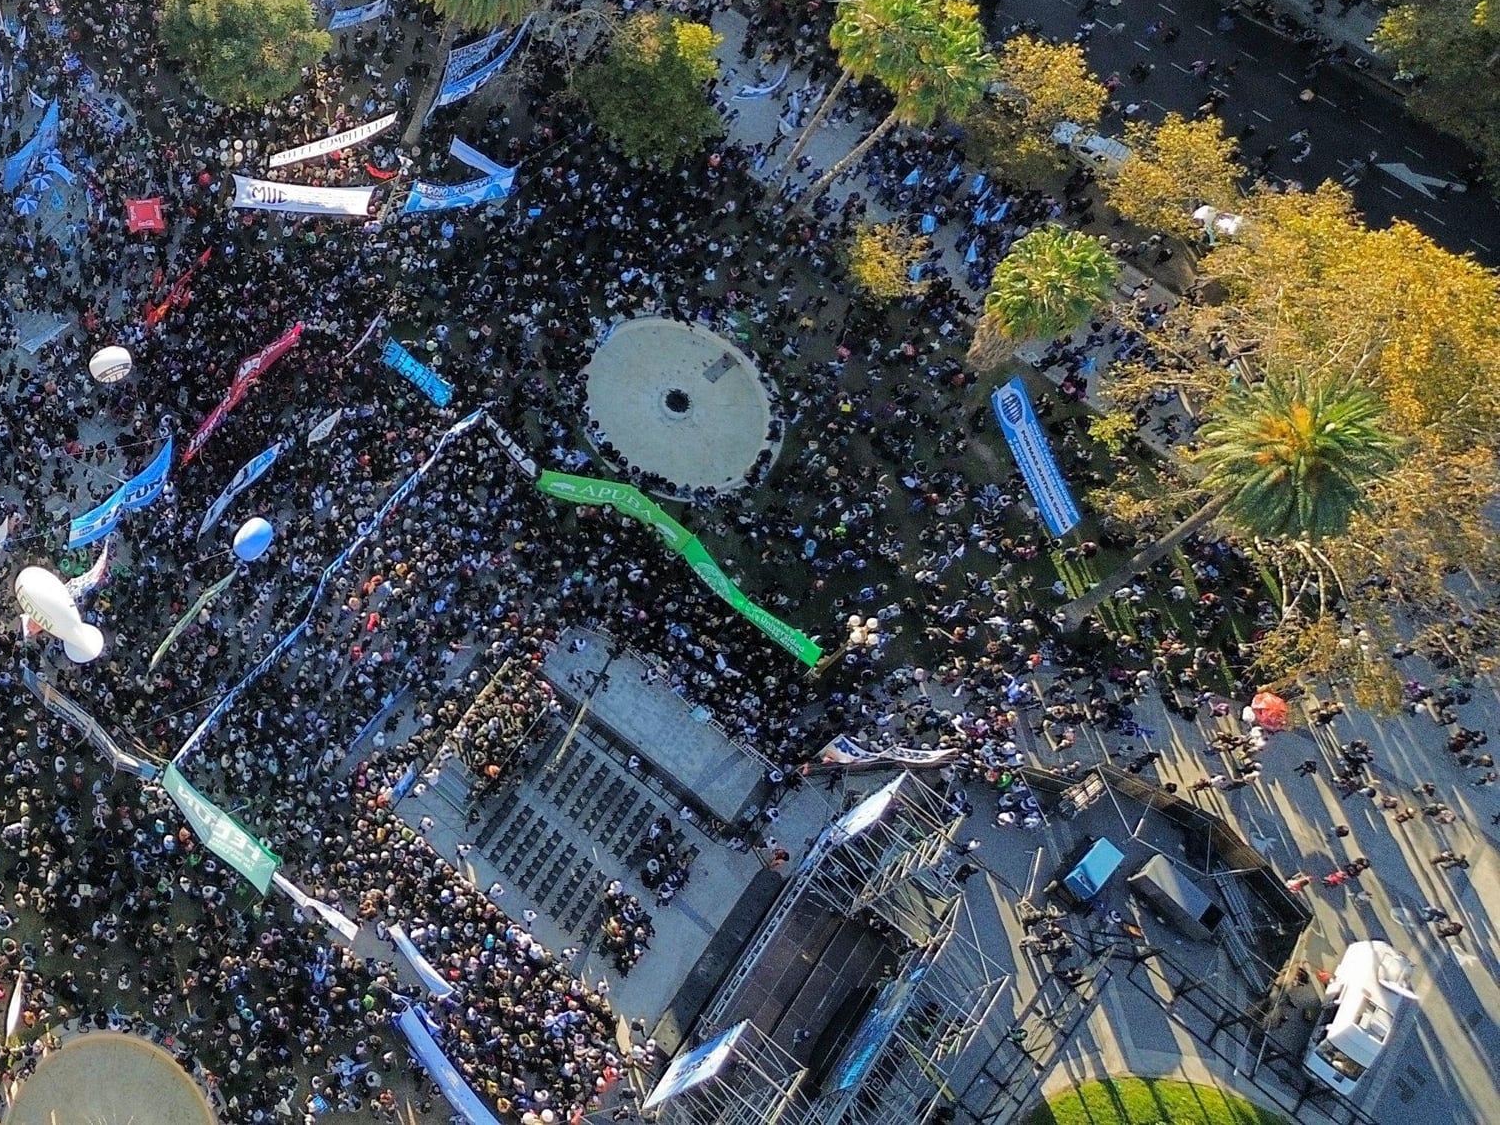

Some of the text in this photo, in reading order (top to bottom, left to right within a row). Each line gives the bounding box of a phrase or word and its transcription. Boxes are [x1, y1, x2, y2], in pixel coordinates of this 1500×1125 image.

[486, 414, 538, 477] FUBA
[578, 476, 657, 522] APUBA
[1018, 429, 1031, 448] POR
[1035, 464, 1056, 502] JUSTICIA
[1051, 499, 1069, 531] SOCIAL
